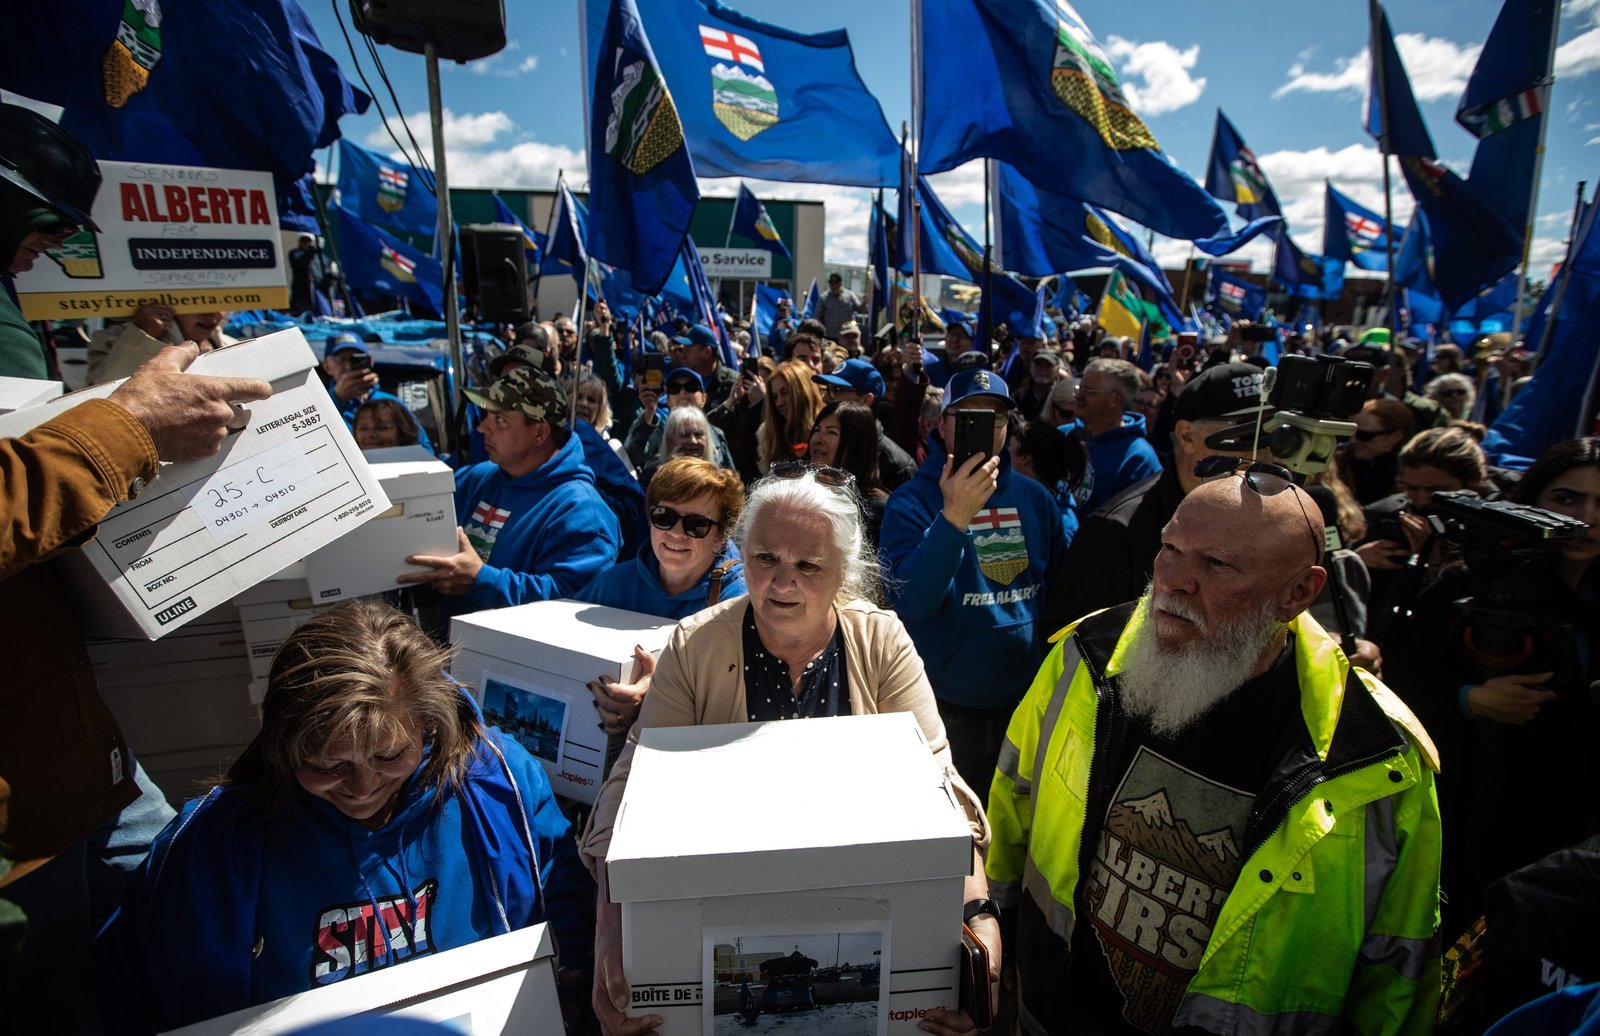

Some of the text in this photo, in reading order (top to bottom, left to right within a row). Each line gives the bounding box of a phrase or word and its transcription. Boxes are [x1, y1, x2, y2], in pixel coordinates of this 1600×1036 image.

[120, 183, 271, 225] ALBERTA
[136, 248, 269, 260] INDEPENDENCE
[713, 252, 766, 265] Service
[59, 292, 261, 313] stayfreealberta.com
[256, 404, 318, 435] LETTER/LEGAL SIZE
[292, 413, 321, 432] S-3887
[270, 506, 308, 529] DESTROY DATE
[115, 528, 152, 549] CONTENTS
[131, 557, 154, 572] FROM
[146, 575, 178, 593] BOX NO.
[962, 591, 995, 606] FREE
[157, 597, 195, 623] ULINE
[314, 883, 434, 985] STAY
[632, 987, 670, 1002] BOÎTE
[674, 988, 692, 1001] DE
[888, 1008, 927, 1021] taple
